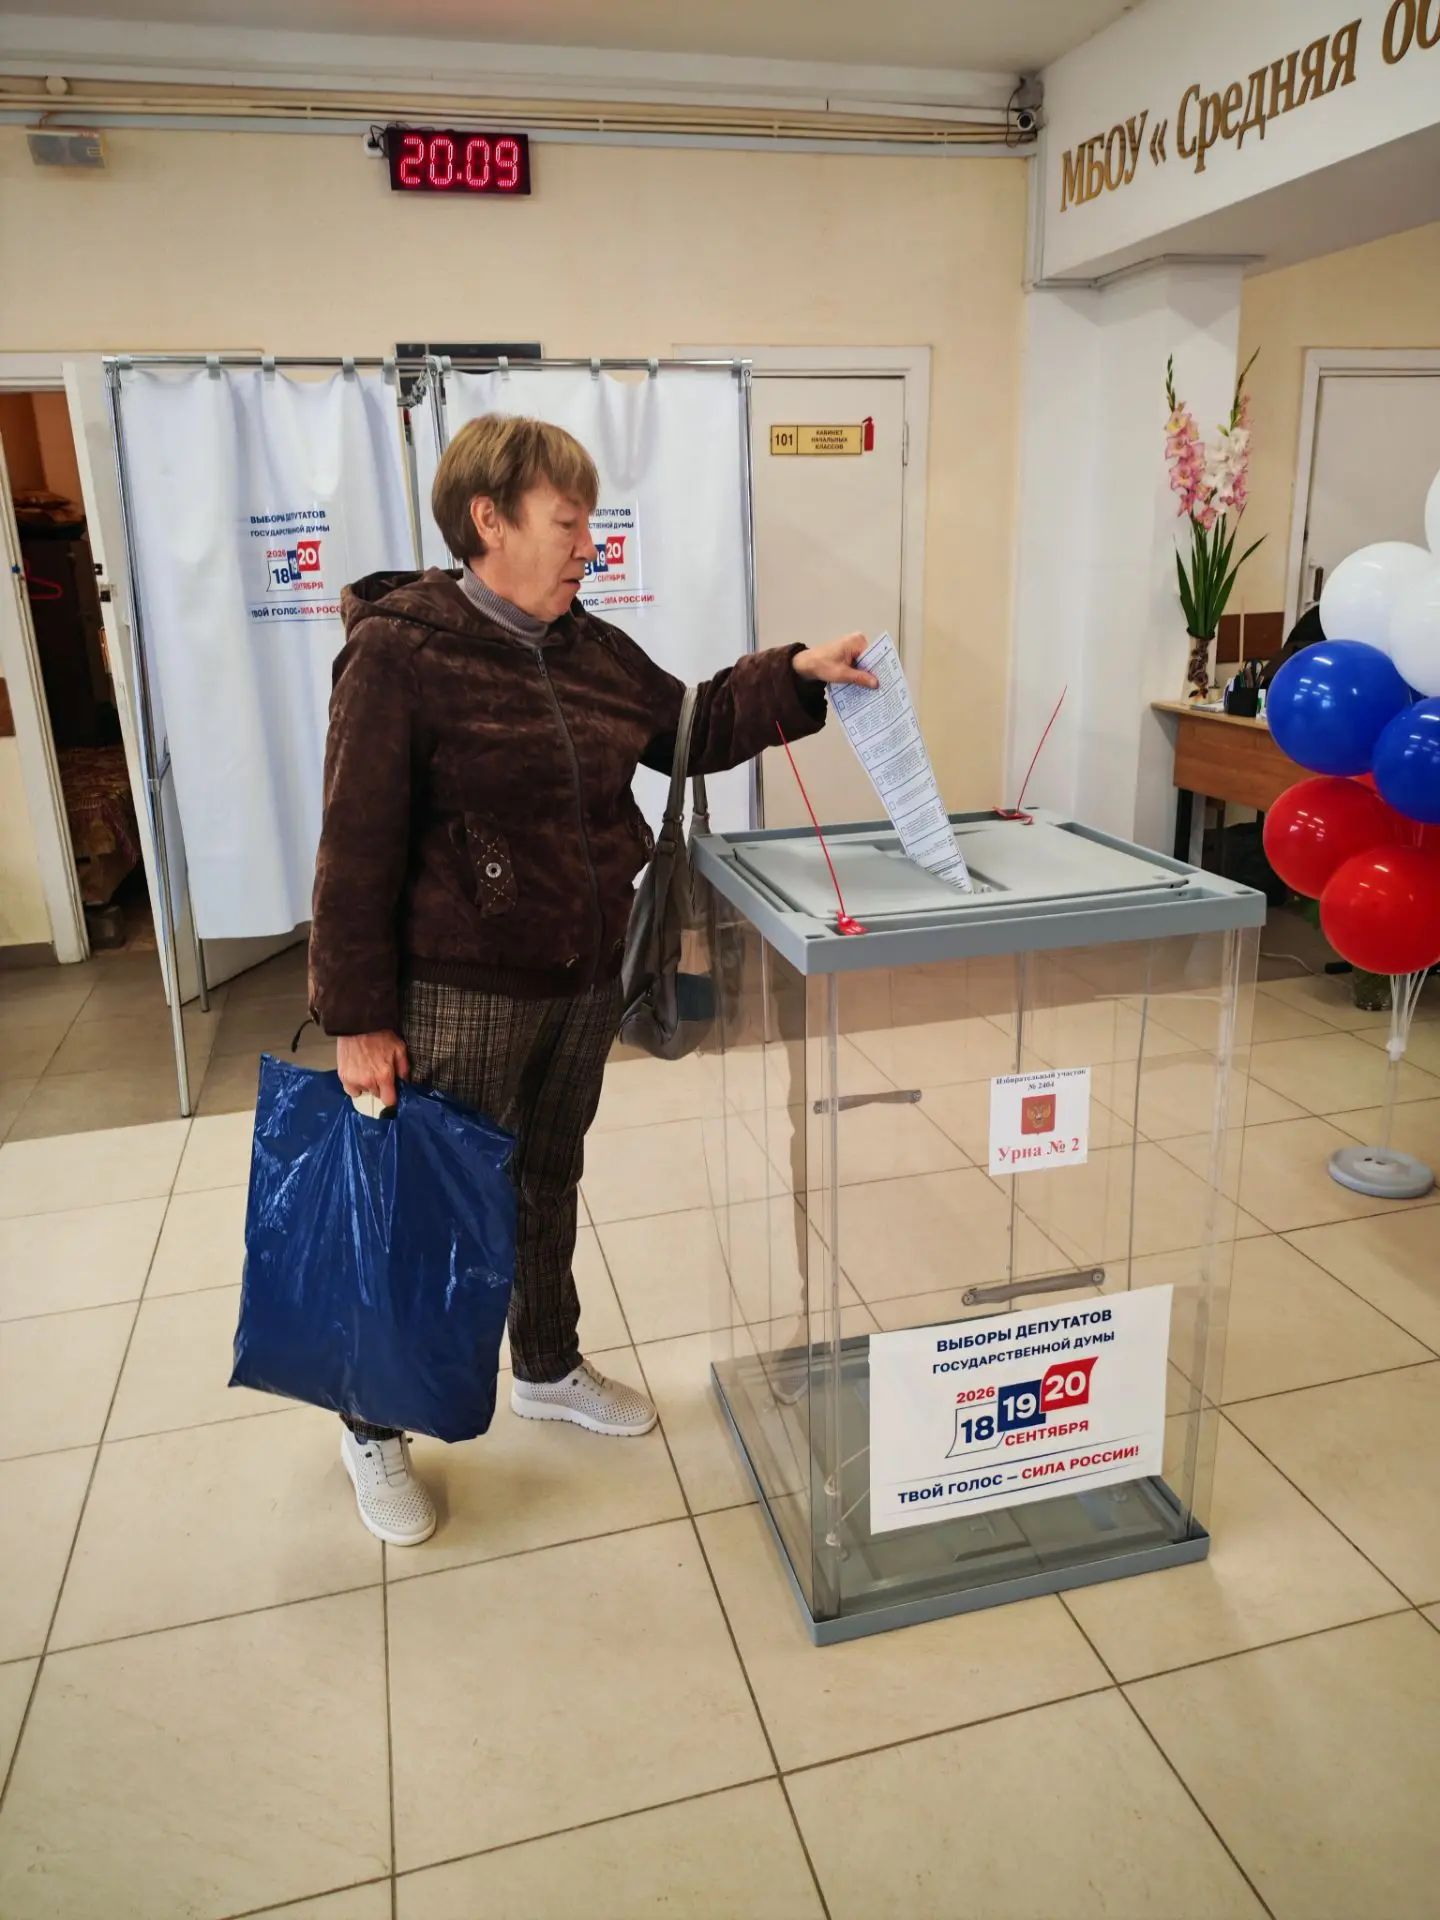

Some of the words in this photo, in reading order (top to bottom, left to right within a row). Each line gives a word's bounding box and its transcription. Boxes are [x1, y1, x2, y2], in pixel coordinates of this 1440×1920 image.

[1060, 109, 1149, 213] МБОУ
[1176, 18, 1362, 175] Средняя
[400, 137, 518, 187] 20.09
[775, 433, 793, 446] 101
[596, 508, 631, 517] ДЕПУТАТОВ
[613, 521, 634, 529] ДУМЫ
[305, 525, 330, 534] ДУМЫ
[266, 549, 286, 558] 2026
[272, 568, 290, 584] 18
[298, 547, 317, 566] 20
[597, 550, 606, 567] 19
[606, 543, 621, 559] 20
[272, 607, 298, 616] ГОЛОС
[996, 1073, 1056, 1085] Избирательный
[1056, 1069, 1086, 1079] участок
[998, 1144, 1041, 1164] Урна
[1046, 1140, 1066, 1155] №
[1071, 1137, 1080, 1152] 2
[936, 1328, 1012, 1353] ВЫБОРЫ
[1015, 1309, 1113, 1340] ДЕПУТАТОВ
[932, 1337, 1071, 1374] ГОСУДАРСТВЕННОЙ
[1073, 1330, 1115, 1350] ДУМЫ
[956, 1386, 996, 1404] 2026
[960, 1415, 995, 1443] 18
[1002, 1393, 1037, 1422] 19
[1044, 1370, 1087, 1402] 20
[1005, 1420, 1089, 1447] СЕНТЯБРЯ
[897, 1483, 943, 1504] ТВОЙ
[948, 1474, 1003, 1495] ГОЛОС
[1021, 1461, 1066, 1480] СИЛА
[1069, 1446, 1139, 1470] РОССИИ!
